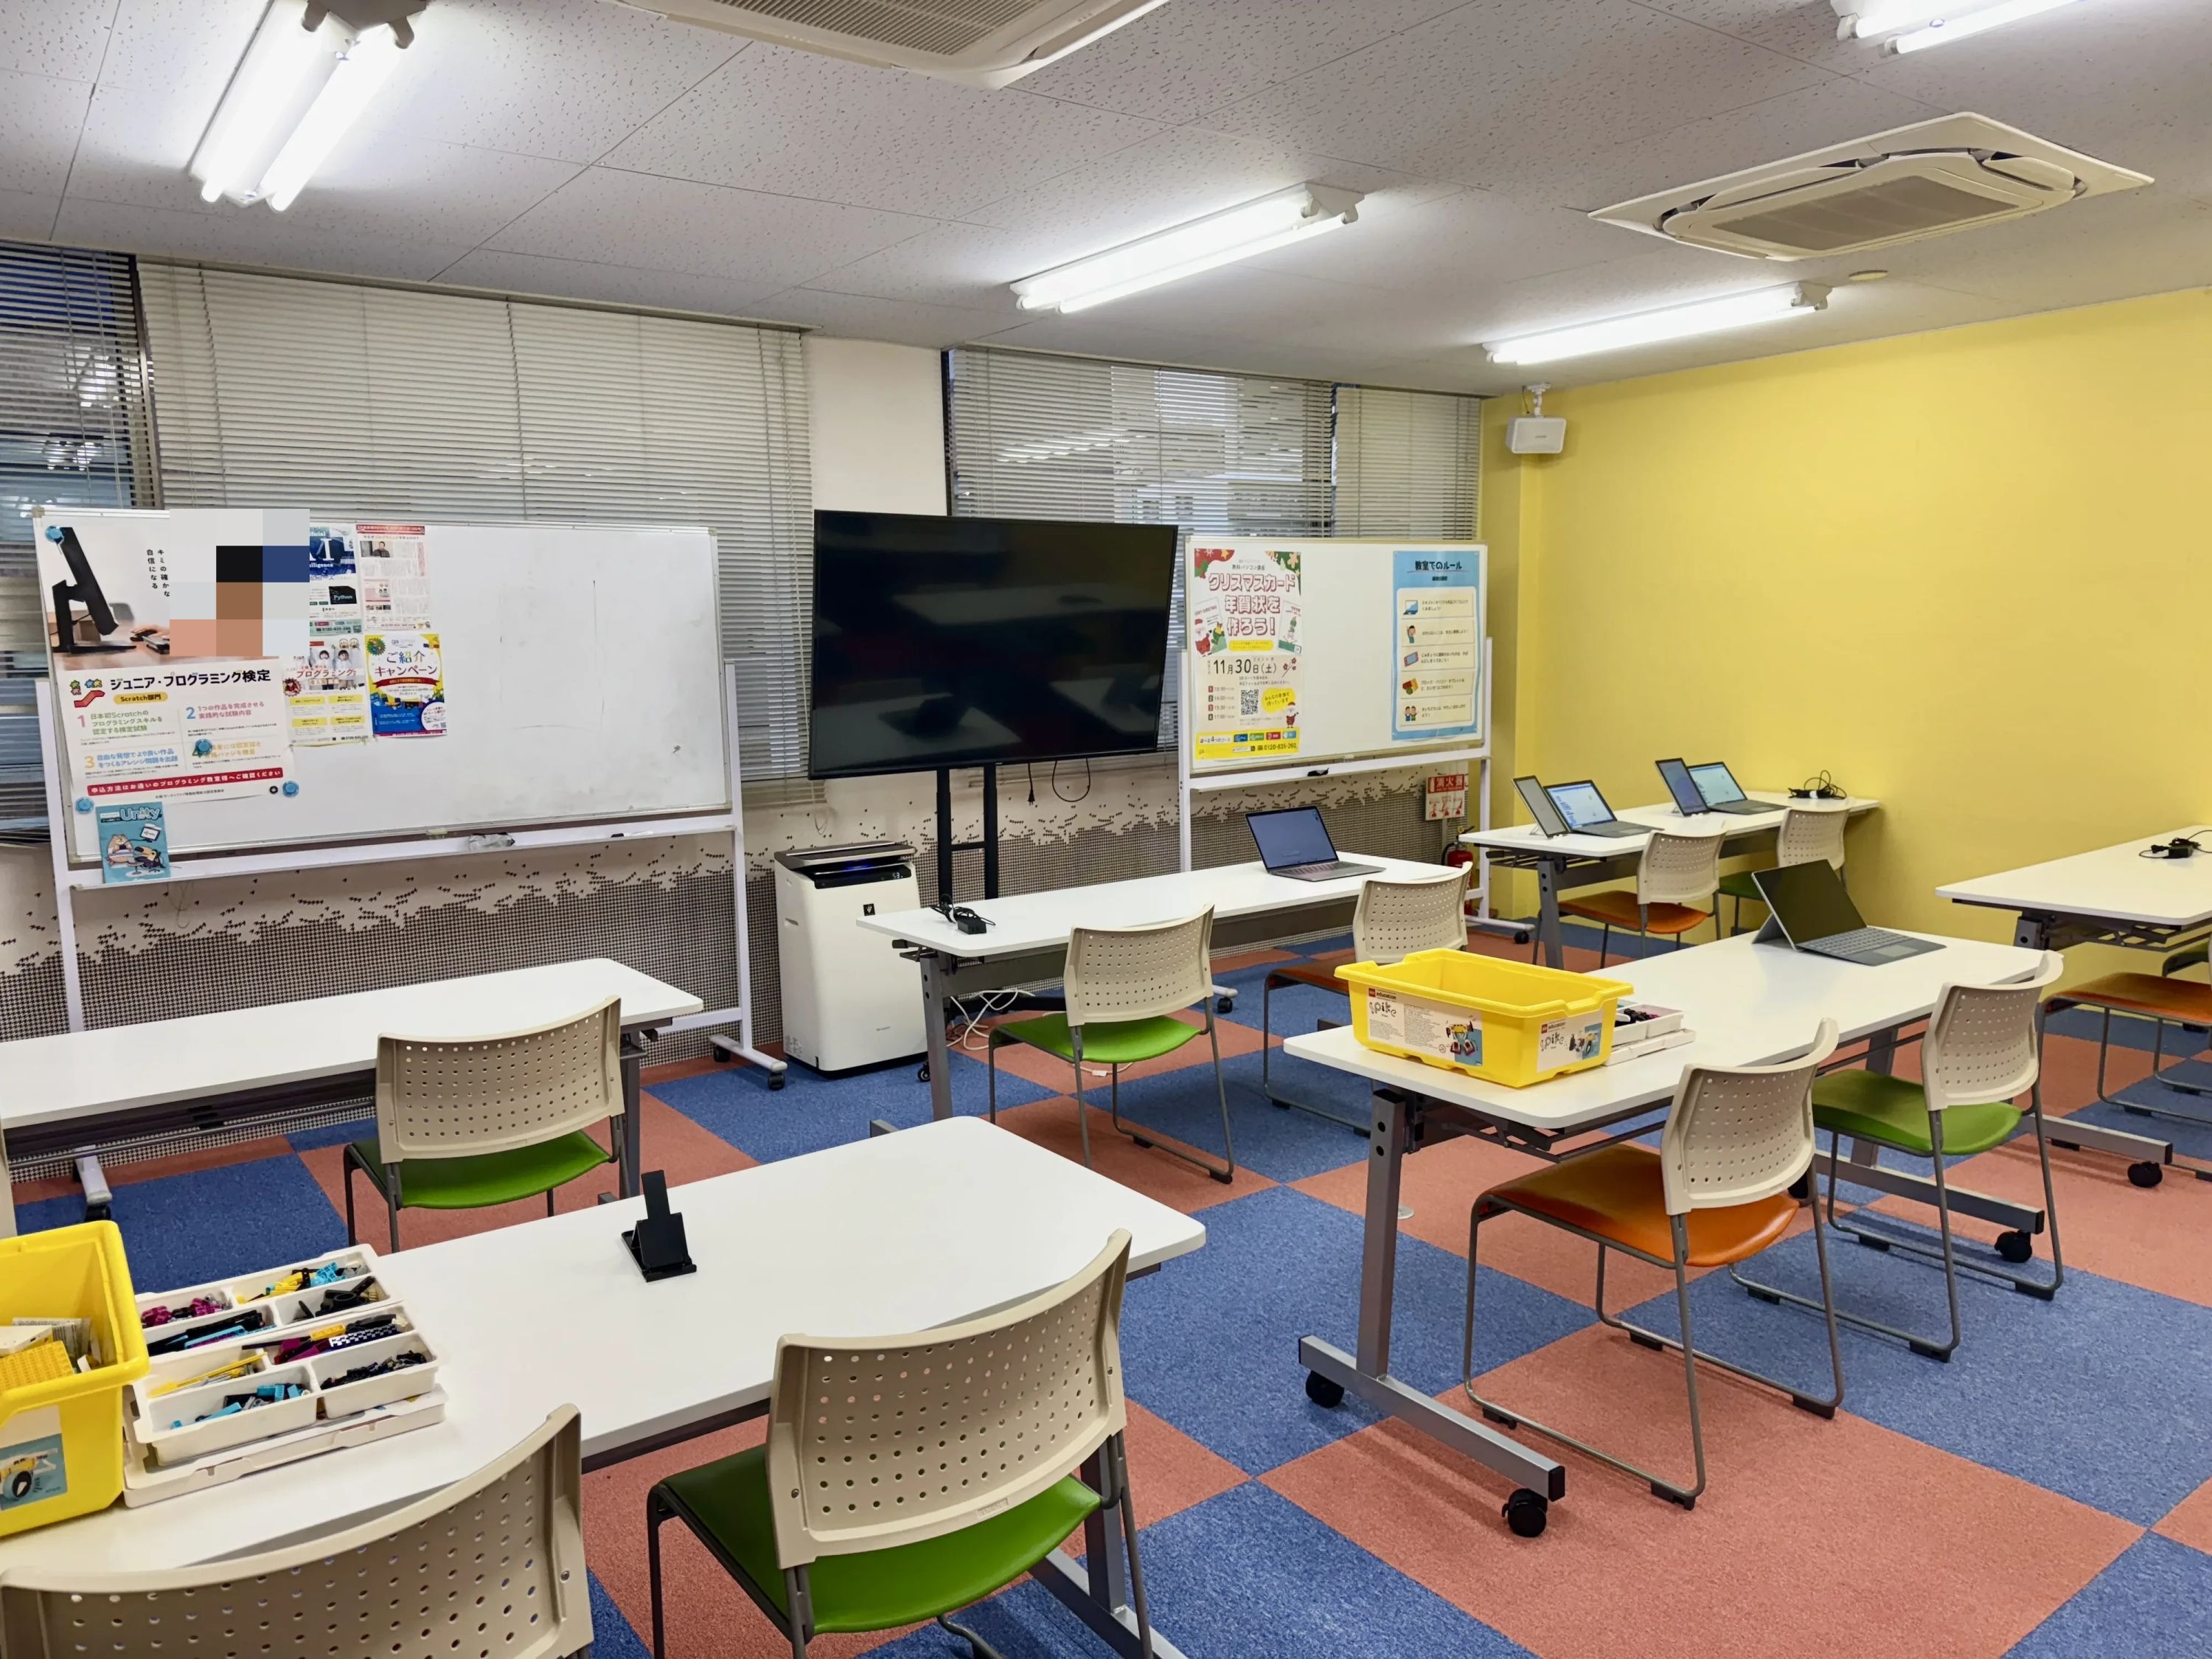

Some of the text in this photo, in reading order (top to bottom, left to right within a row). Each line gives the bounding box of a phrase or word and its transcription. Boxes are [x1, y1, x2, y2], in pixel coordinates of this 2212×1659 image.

[147, 549, 158, 589] 自信になる
[1415, 560, 1462, 571] 教室でのルール
[158, 549, 170, 597] キミの確かな
[1208, 573, 1295, 593] クリスマスカード
[1225, 595, 1281, 614] 年賀状を
[387, 650, 425, 664] ご紹介
[296, 669, 355, 678] プログラミング
[375, 665, 437, 677] キャンペーン
[110, 669, 271, 691] ジュニア・プログラミング検定
[120, 694, 162, 702] Scratch部門
[198, 701, 265, 712] 1つの作品を完成させる
[91, 710, 149, 720] 日本初Scratchの
[186, 707, 196, 720] 2
[198, 710, 252, 720] 実践的な試験内容
[77, 714, 86, 728] 1
[92, 717, 163, 727] プログラミングスキルを
[93, 725, 147, 735] 認定する検定試験
[97, 748, 174, 761] 自由な発想でより良い作品
[84, 755, 95, 768] 3
[98, 755, 178, 768] をつくるアレンジ問題を出題
[1436, 775, 1463, 788] 消火器
[120, 807, 161, 821] Unity
